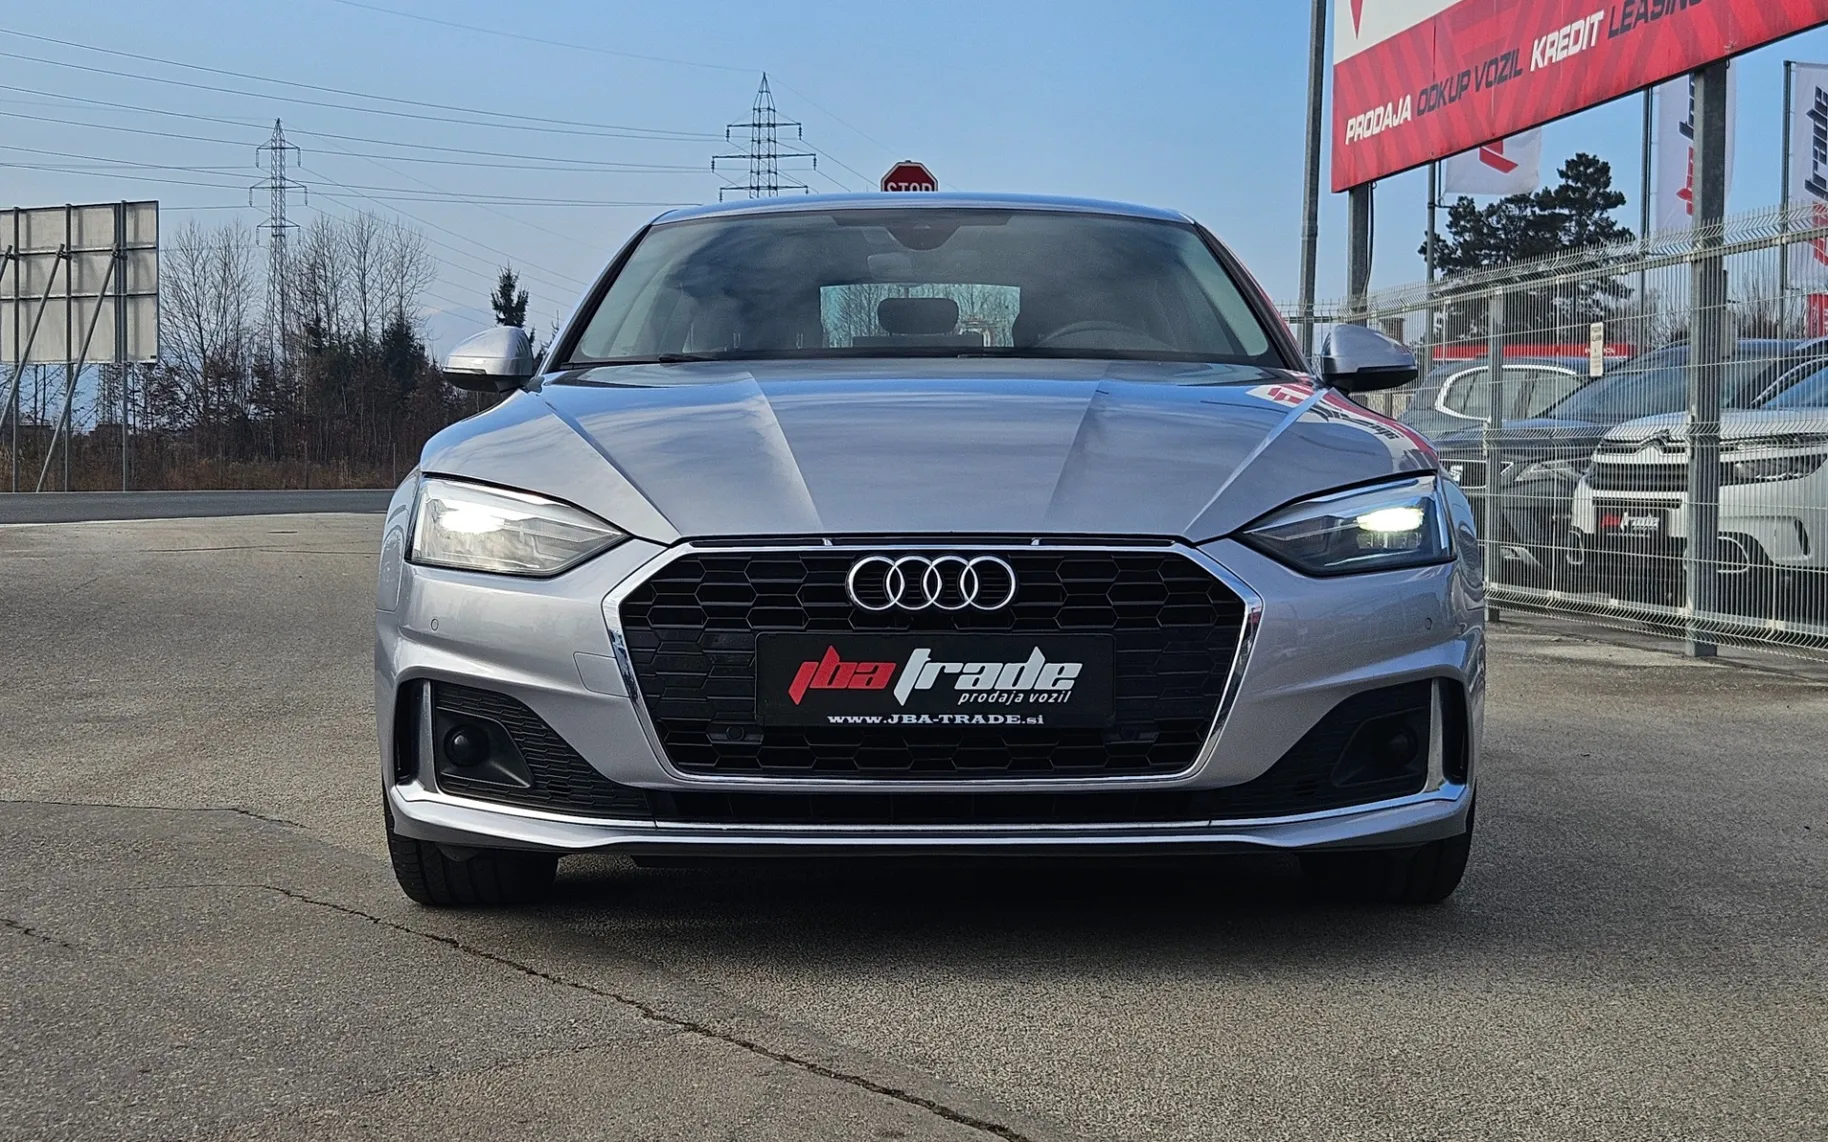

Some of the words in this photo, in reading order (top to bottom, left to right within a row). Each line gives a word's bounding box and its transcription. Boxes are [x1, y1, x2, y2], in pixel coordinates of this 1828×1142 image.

[1345, 94, 1412, 145] PRODAJA
[1417, 69, 1471, 117] ODKUP
[1475, 48, 1523, 93] VOZIL
[1530, 10, 1605, 72] KREDIT
[1607, 0, 1703, 39] LEAS
[893, 646, 1083, 706] trade
[957, 690, 1024, 706] prodaja
[1029, 690, 1072, 703] vozil
[827, 713, 1044, 725] www.JBA-TRADE.si
